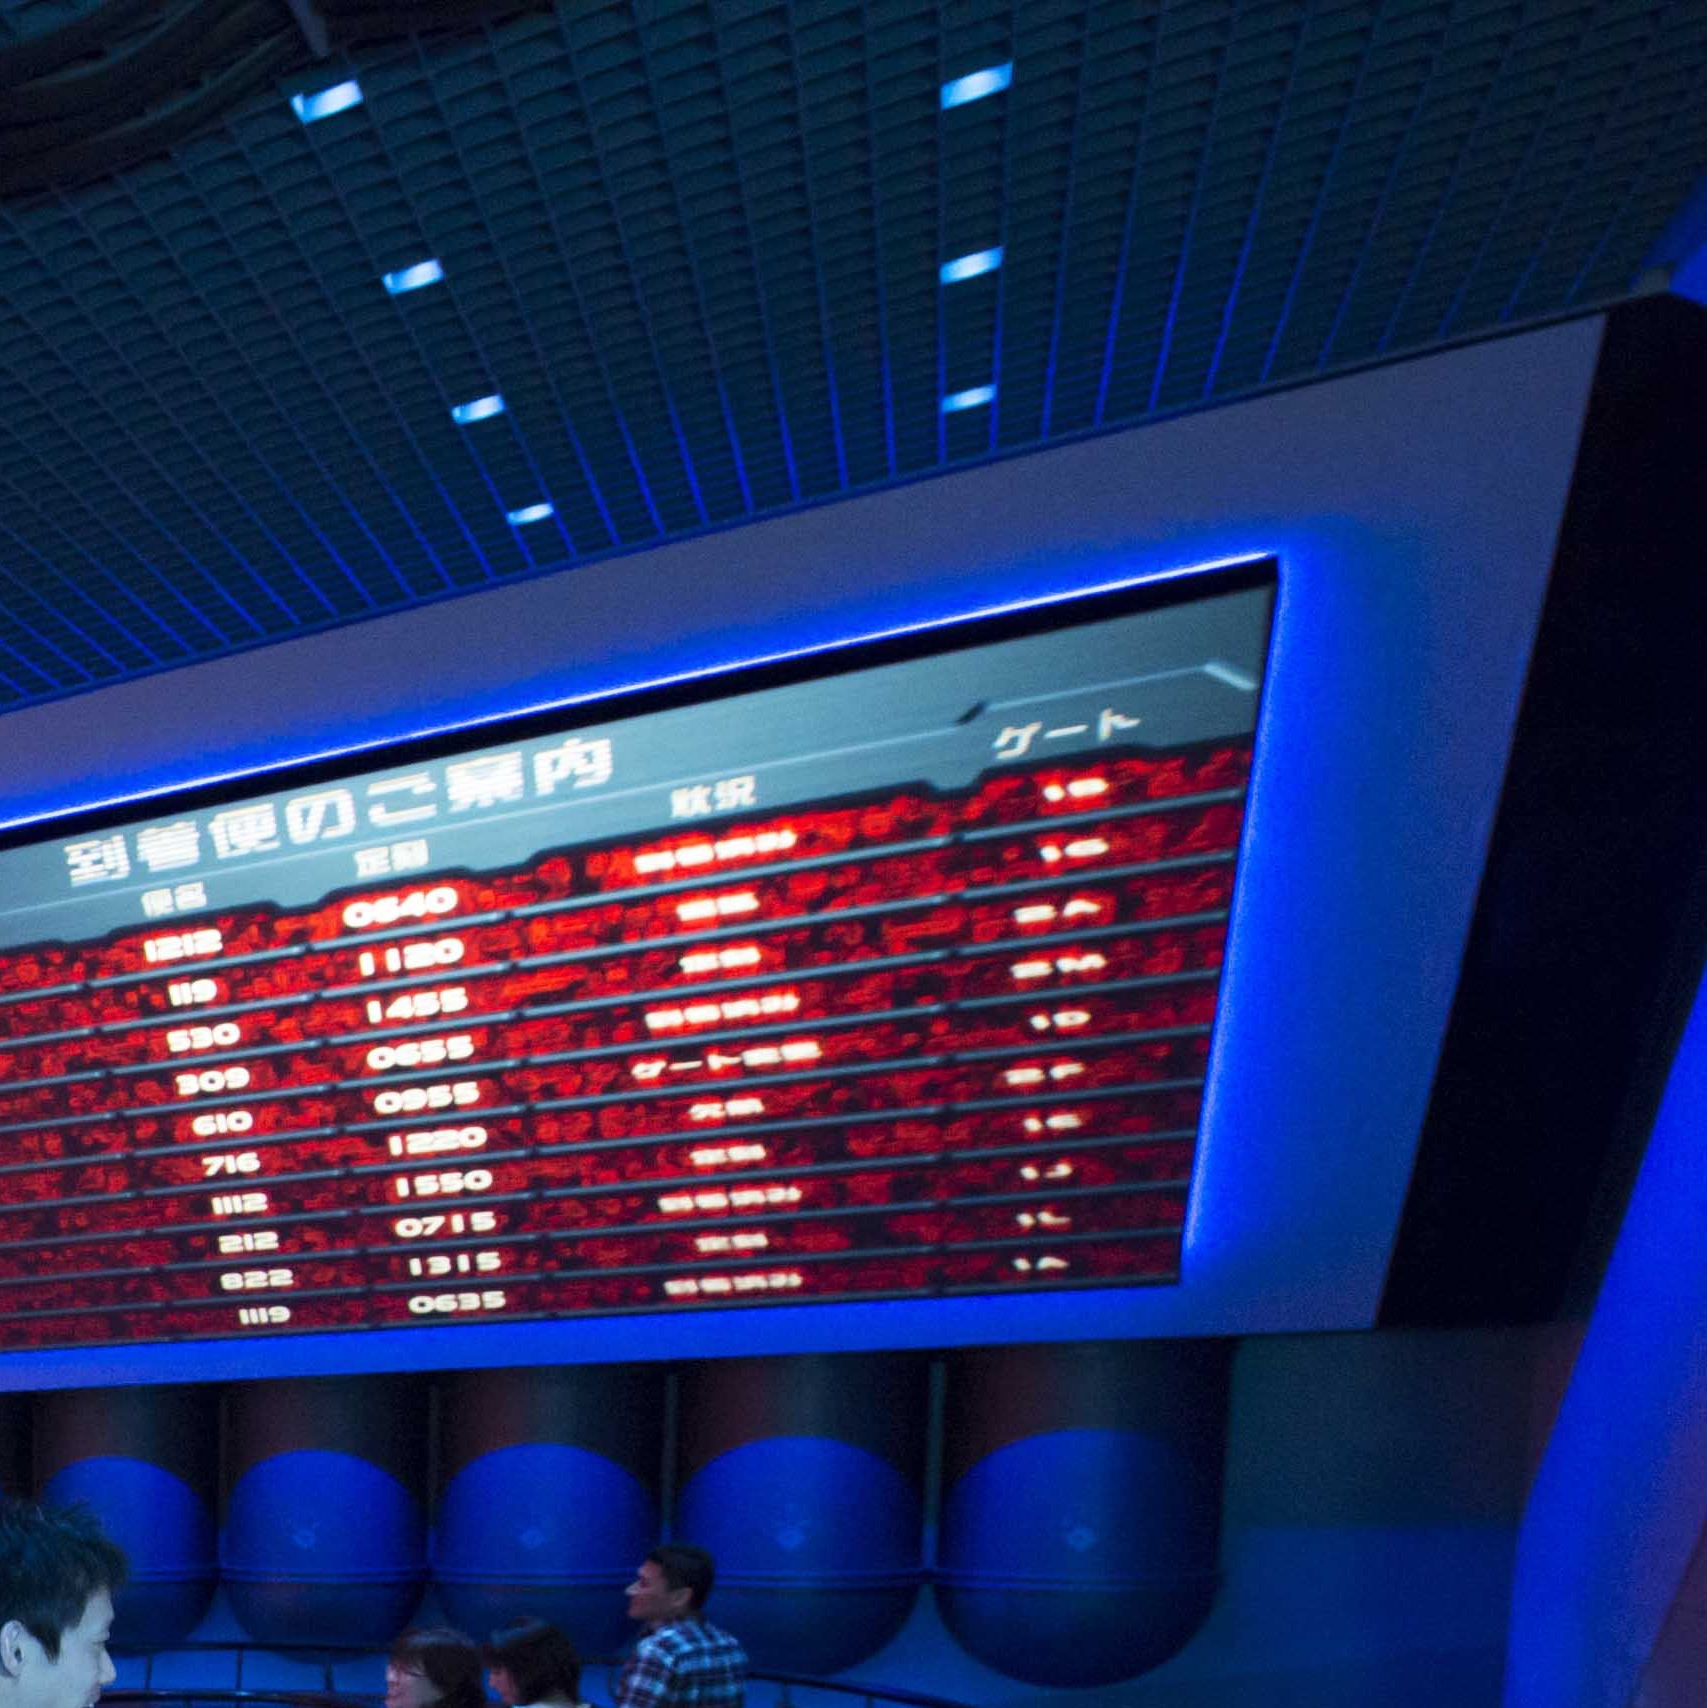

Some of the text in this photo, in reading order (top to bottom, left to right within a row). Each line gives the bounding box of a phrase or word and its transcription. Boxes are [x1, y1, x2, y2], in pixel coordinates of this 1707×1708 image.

[991, 708, 1141, 760] ゲート
[63, 737, 614, 888] 到着便のご案内
[143, 929, 223, 963] 1212
[167, 1023, 240, 1052] 530
[366, 987, 469, 1024] 1455
[176, 1067, 250, 1095] 309
[193, 1111, 253, 1135] 610
[203, 1152, 260, 1176] 716
[212, 1193, 267, 1214] 1112
[397, 1170, 492, 1197] 1550
[219, 1232, 278, 1253] 212
[396, 1212, 496, 1237] 0715
